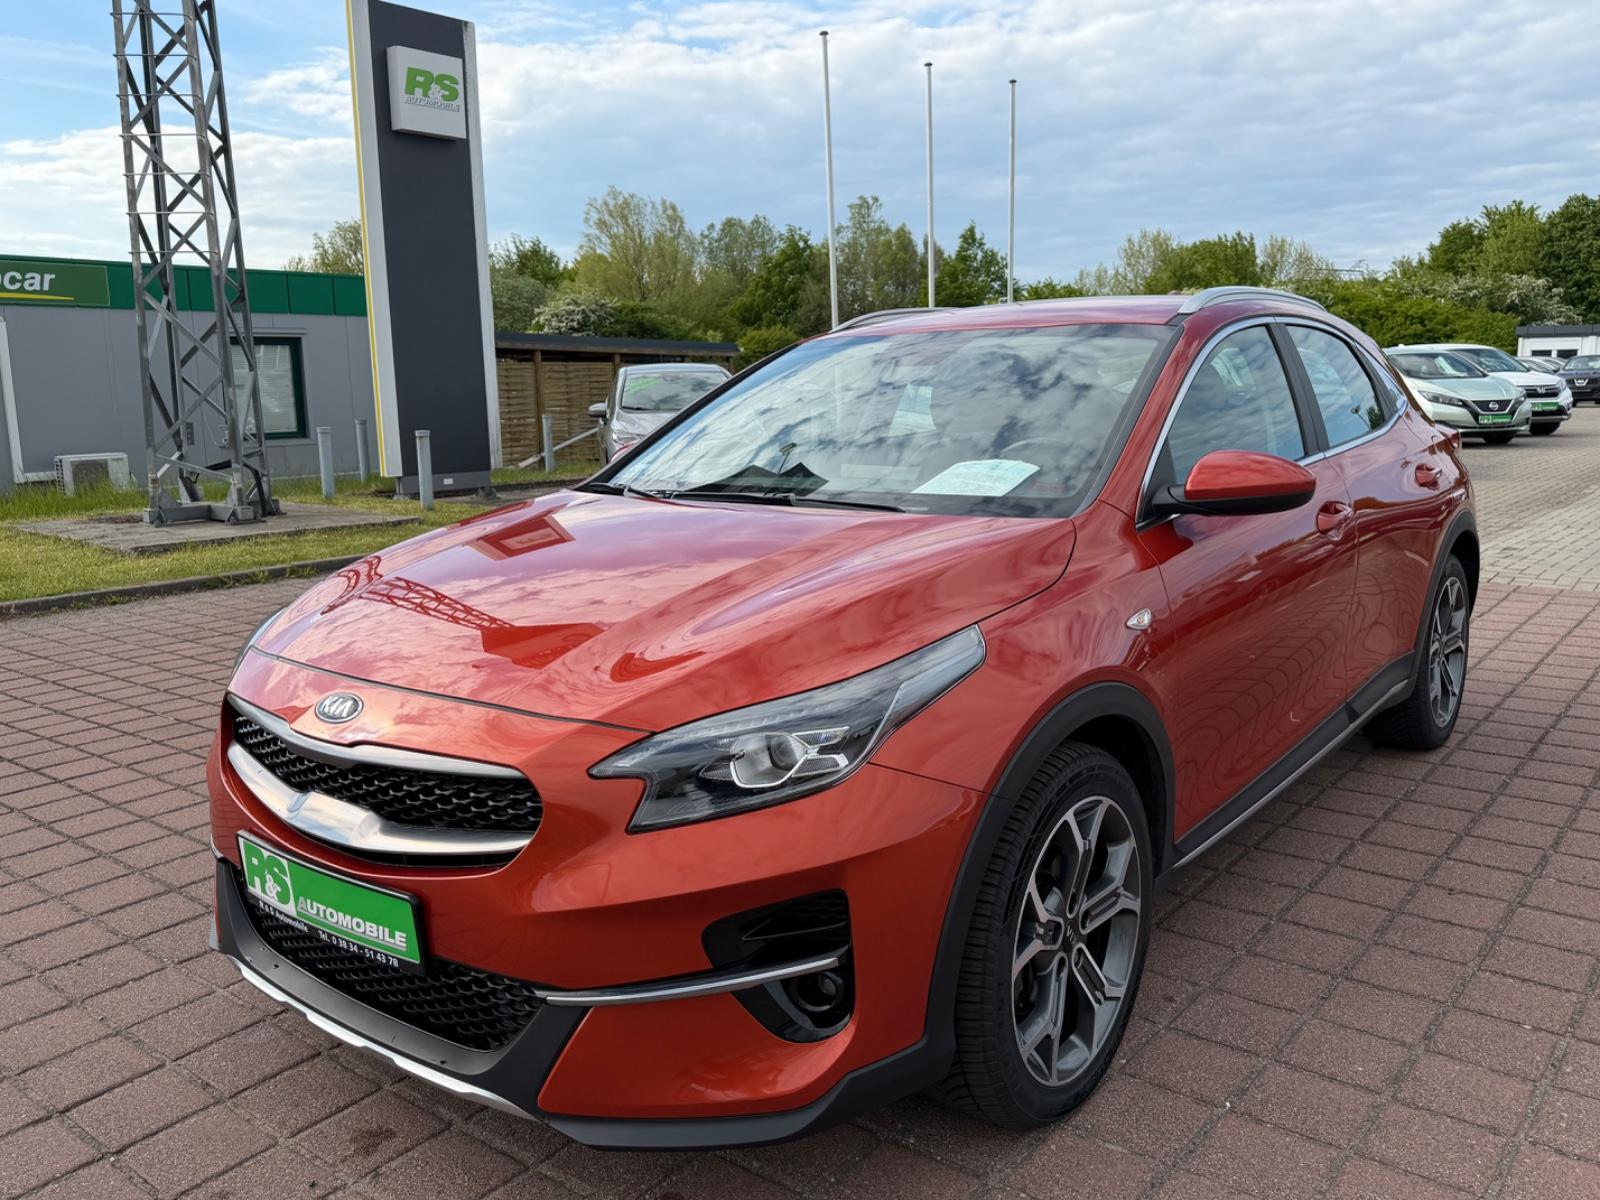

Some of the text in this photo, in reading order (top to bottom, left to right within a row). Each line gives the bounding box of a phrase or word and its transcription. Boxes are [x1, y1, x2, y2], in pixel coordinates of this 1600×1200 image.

[405, 67, 459, 102] R&S
[0, 271, 56, 291] car
[319, 696, 353, 717] KIA
[243, 840, 291, 907] R&S
[297, 895, 407, 947] AUTOMOBILE
